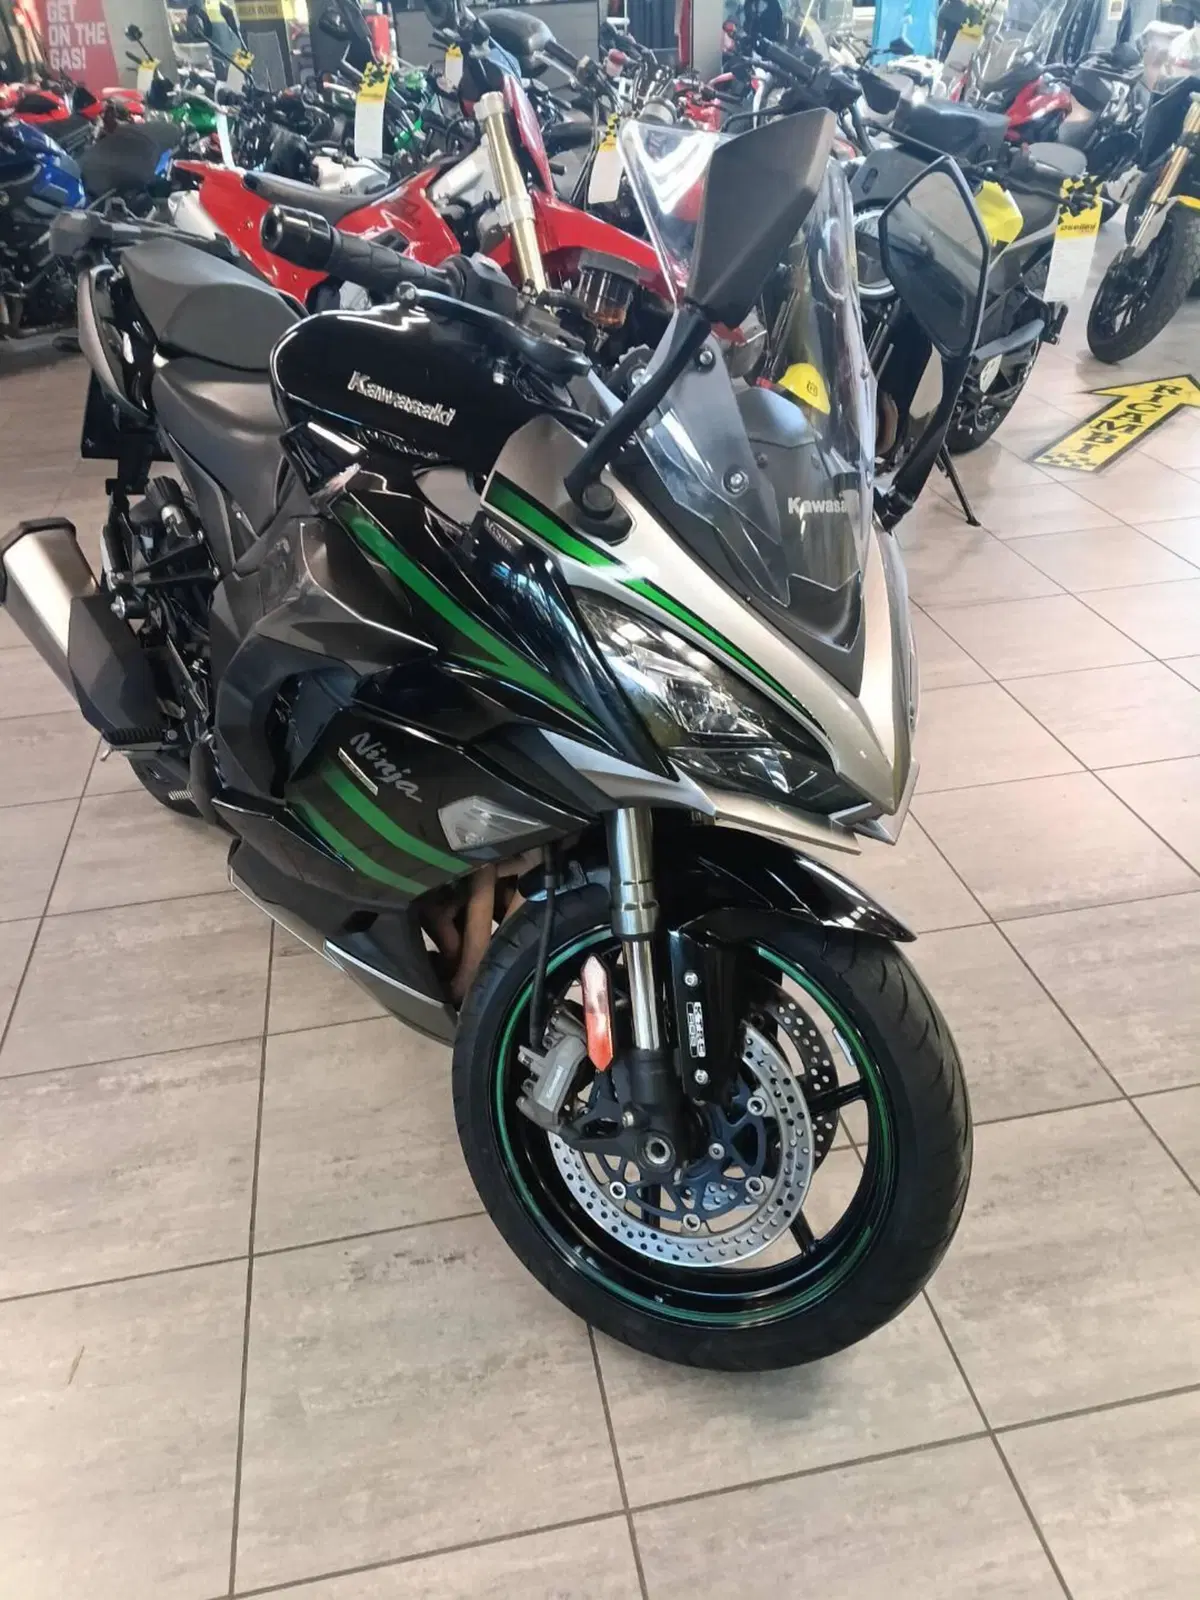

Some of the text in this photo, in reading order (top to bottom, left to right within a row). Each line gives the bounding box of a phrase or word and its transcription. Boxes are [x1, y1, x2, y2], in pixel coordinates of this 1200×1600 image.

[47, 0, 76, 23] GET
[48, 22, 107, 47] ON THE
[50, 47, 87, 71] GAS!
[347, 370, 456, 427] Kawasaki
[1071, 384, 1183, 455] RICAMBI
[350, 732, 423, 803] Ninja
